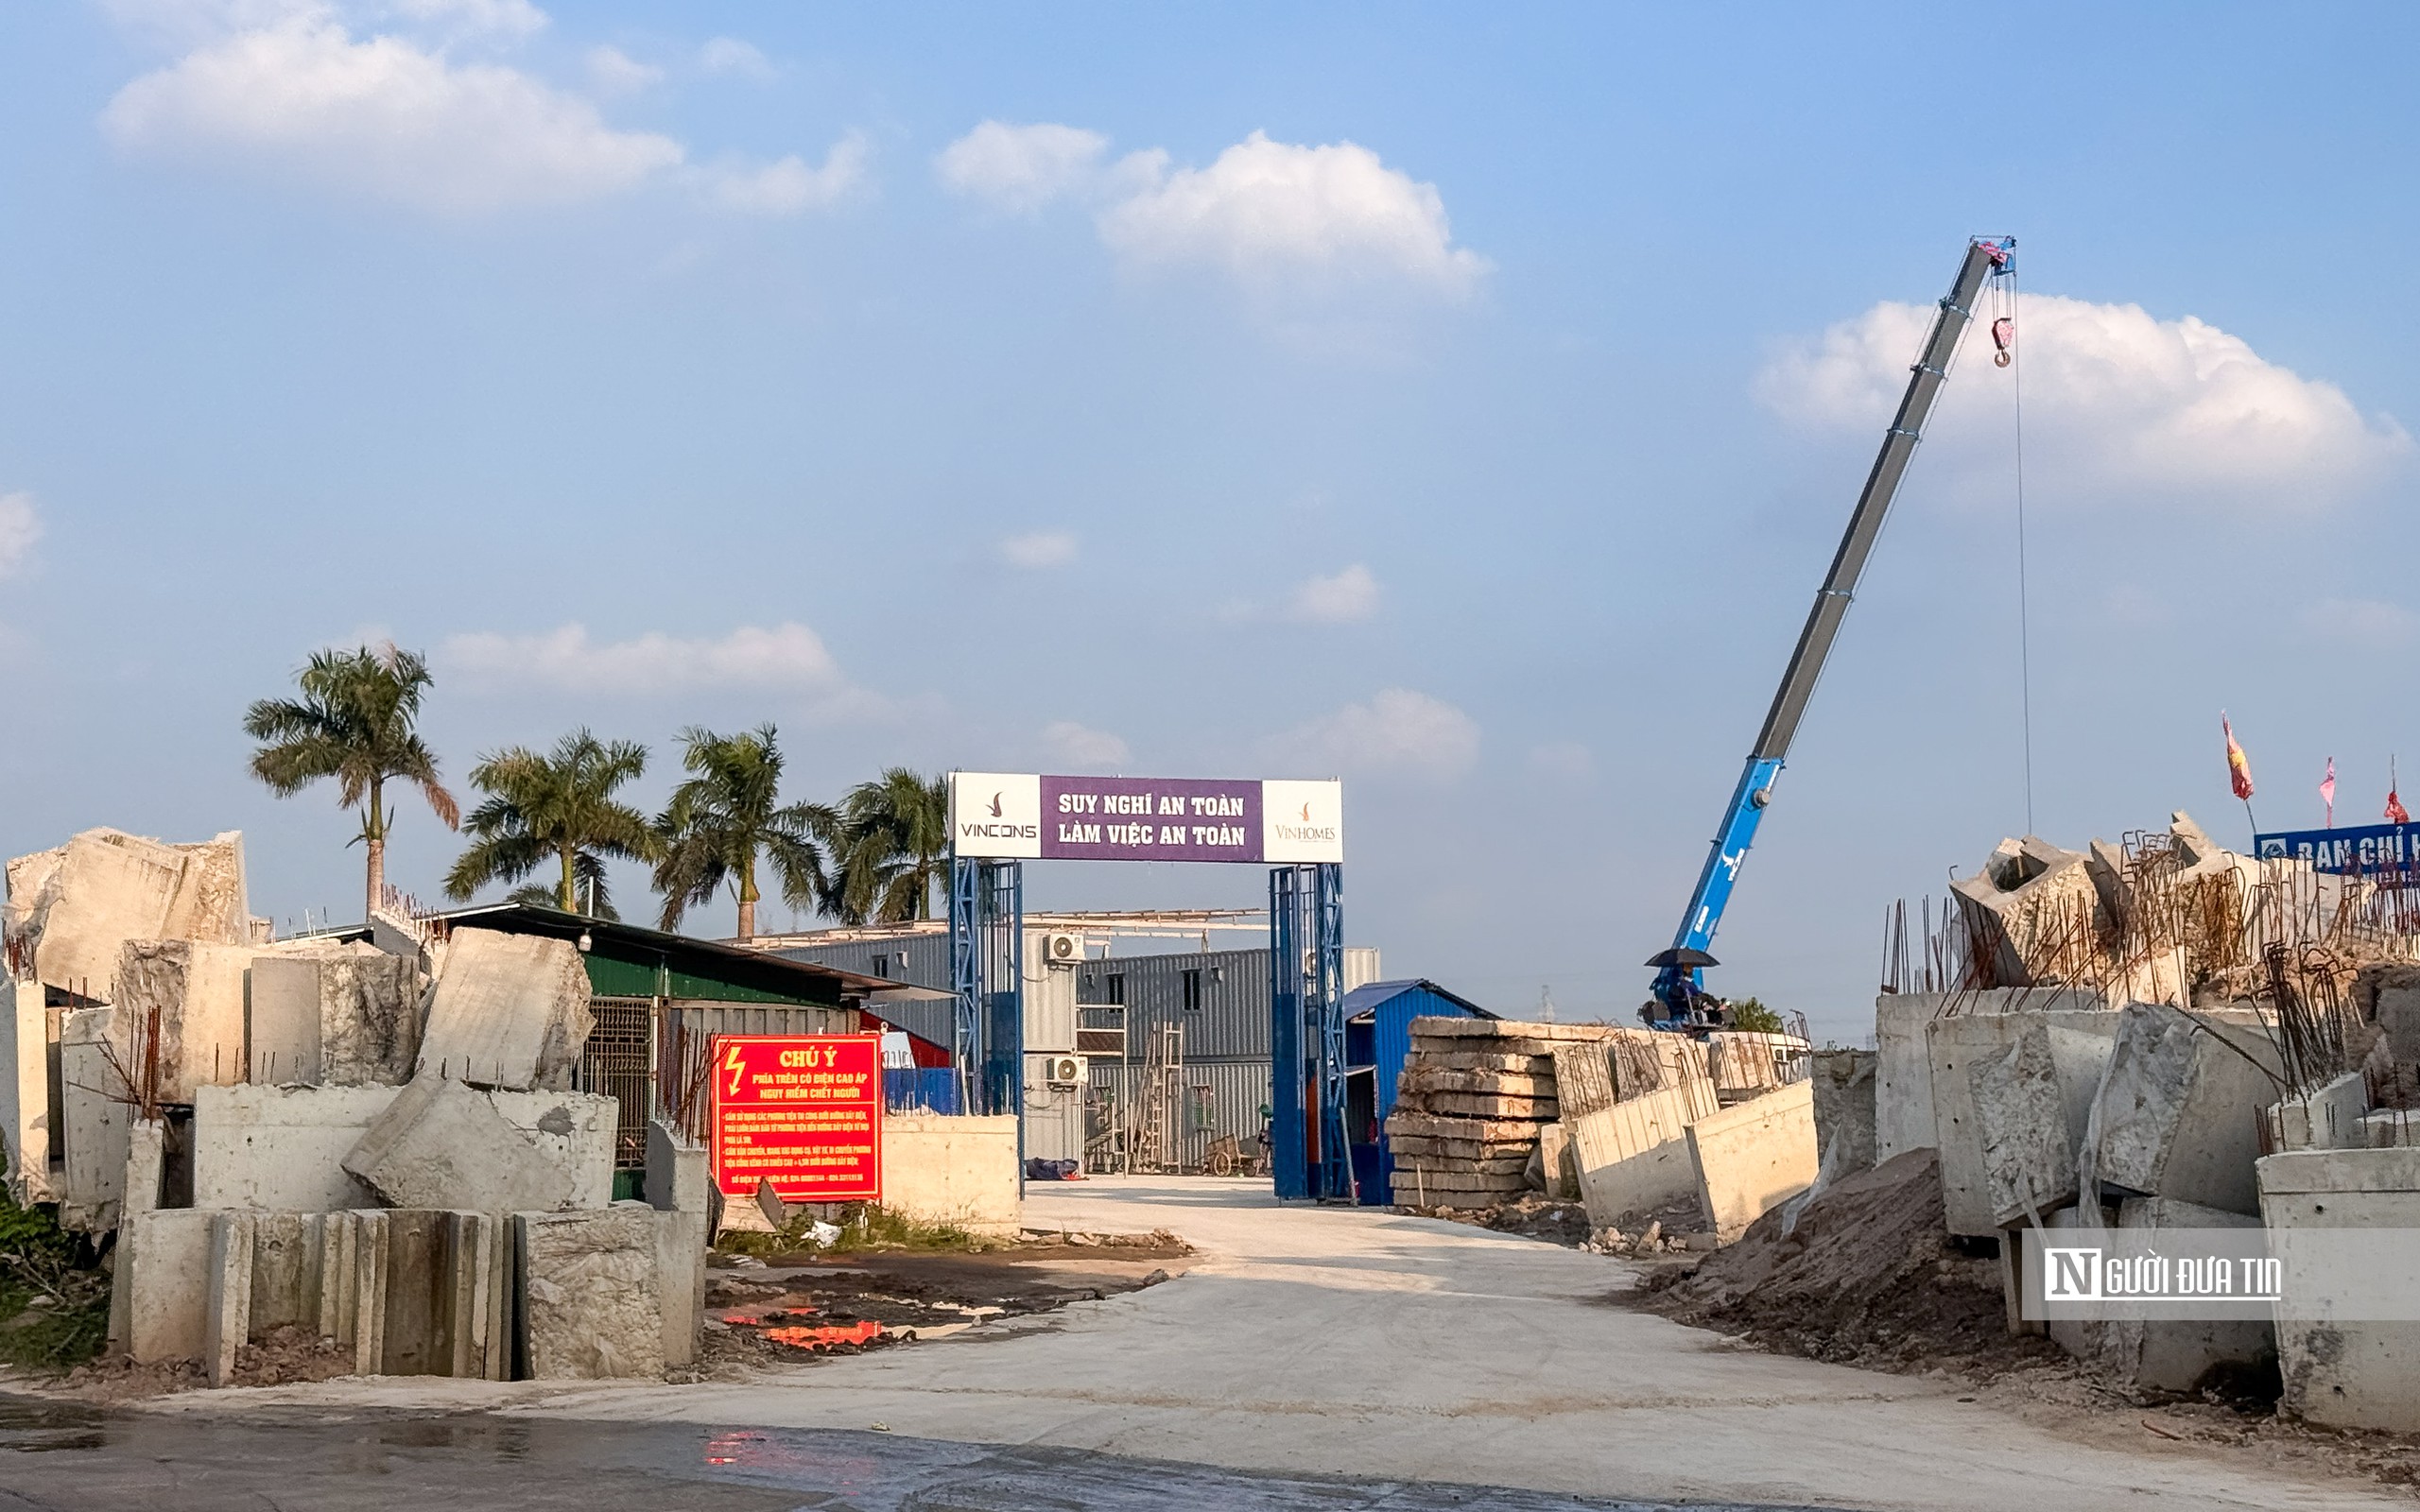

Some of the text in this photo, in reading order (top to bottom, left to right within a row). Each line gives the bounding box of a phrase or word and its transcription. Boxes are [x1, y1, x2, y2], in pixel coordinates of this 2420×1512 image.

[1059, 793, 1098, 814] SUY
[1158, 797, 1185, 816] AN
[1191, 794, 1244, 816] TOÀN
[960, 823, 1037, 838] VINCONS
[1059, 820, 1245, 848] LÀM VIỆC AN TOÀN
[779, 1045, 838, 1068] CHÚ Ý
[836, 1074, 854, 1084] CAO
[855, 1072, 868, 1084] ÁP
